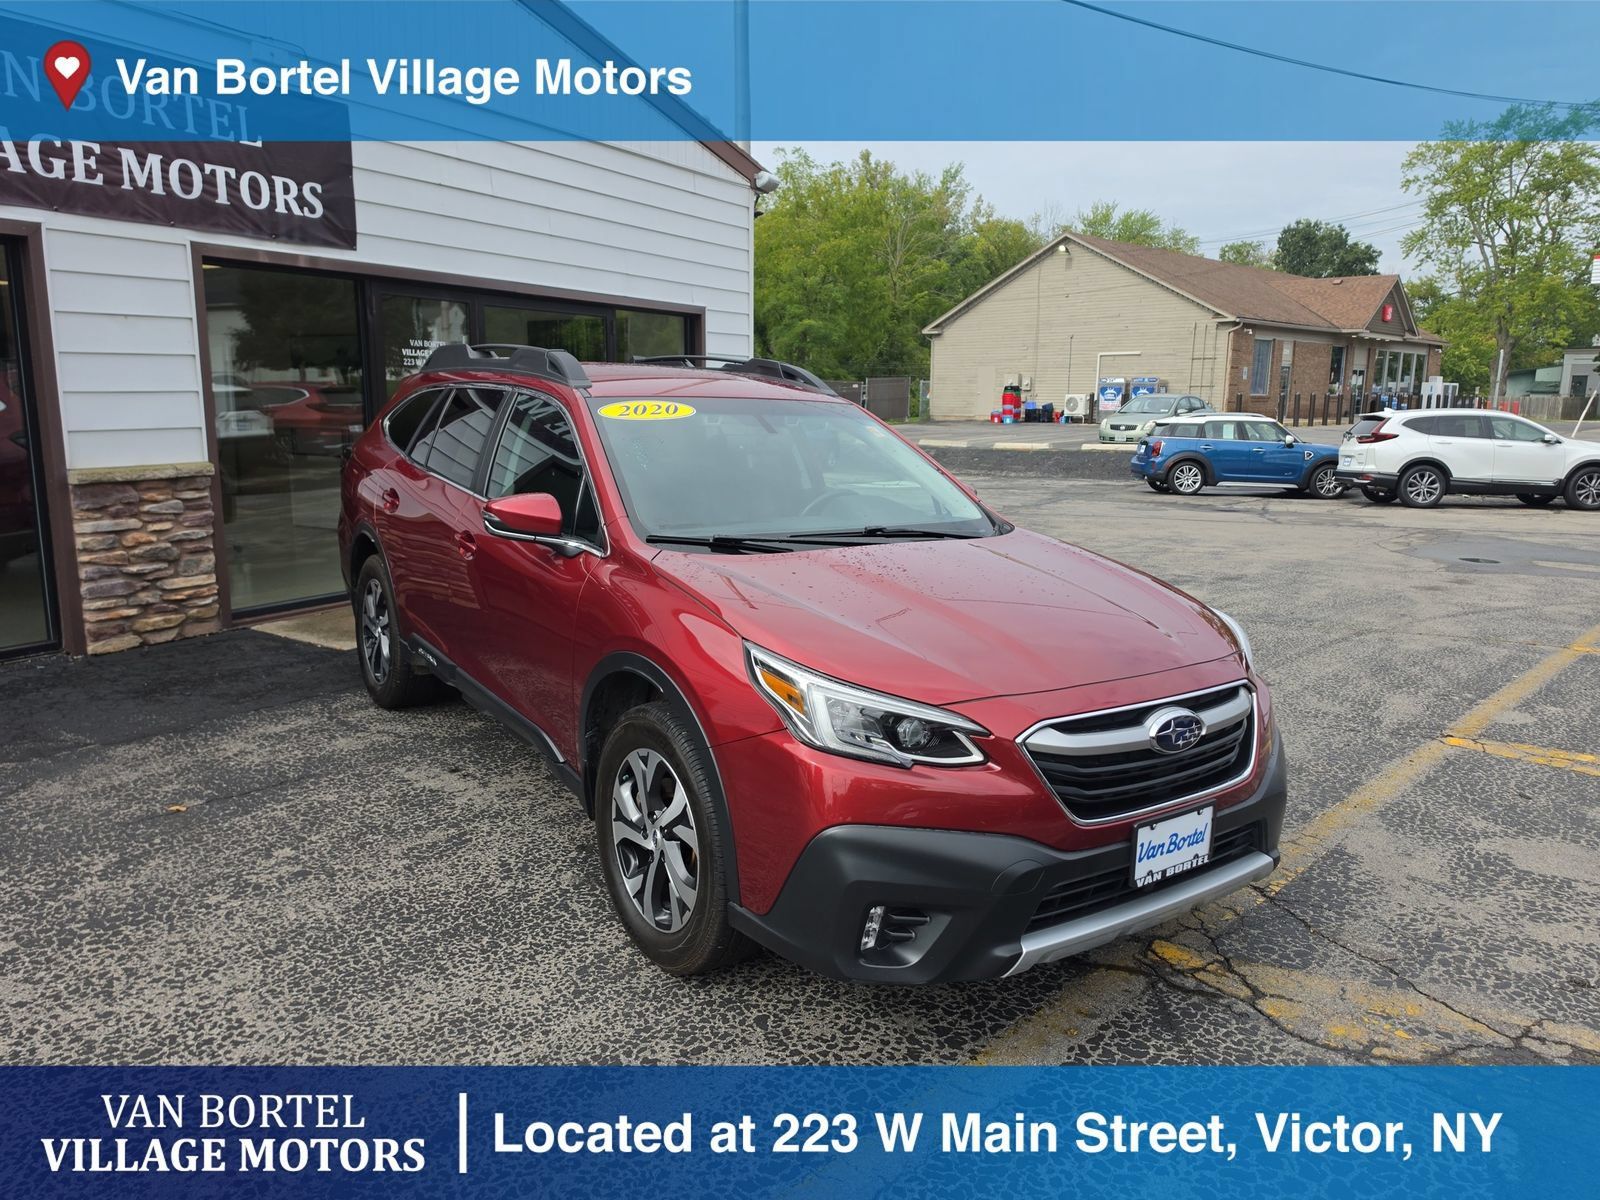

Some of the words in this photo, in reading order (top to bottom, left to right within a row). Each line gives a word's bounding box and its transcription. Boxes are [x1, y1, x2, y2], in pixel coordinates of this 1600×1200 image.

[117, 147, 324, 219] MOTORS
[403, 358, 415, 366] 223
[618, 404, 679, 417] 2020
[1138, 840, 1165, 863] Van
[1166, 823, 1208, 854] Bortel
[1136, 872, 1162, 888] VAN
[1166, 855, 1209, 877] BORTEL
